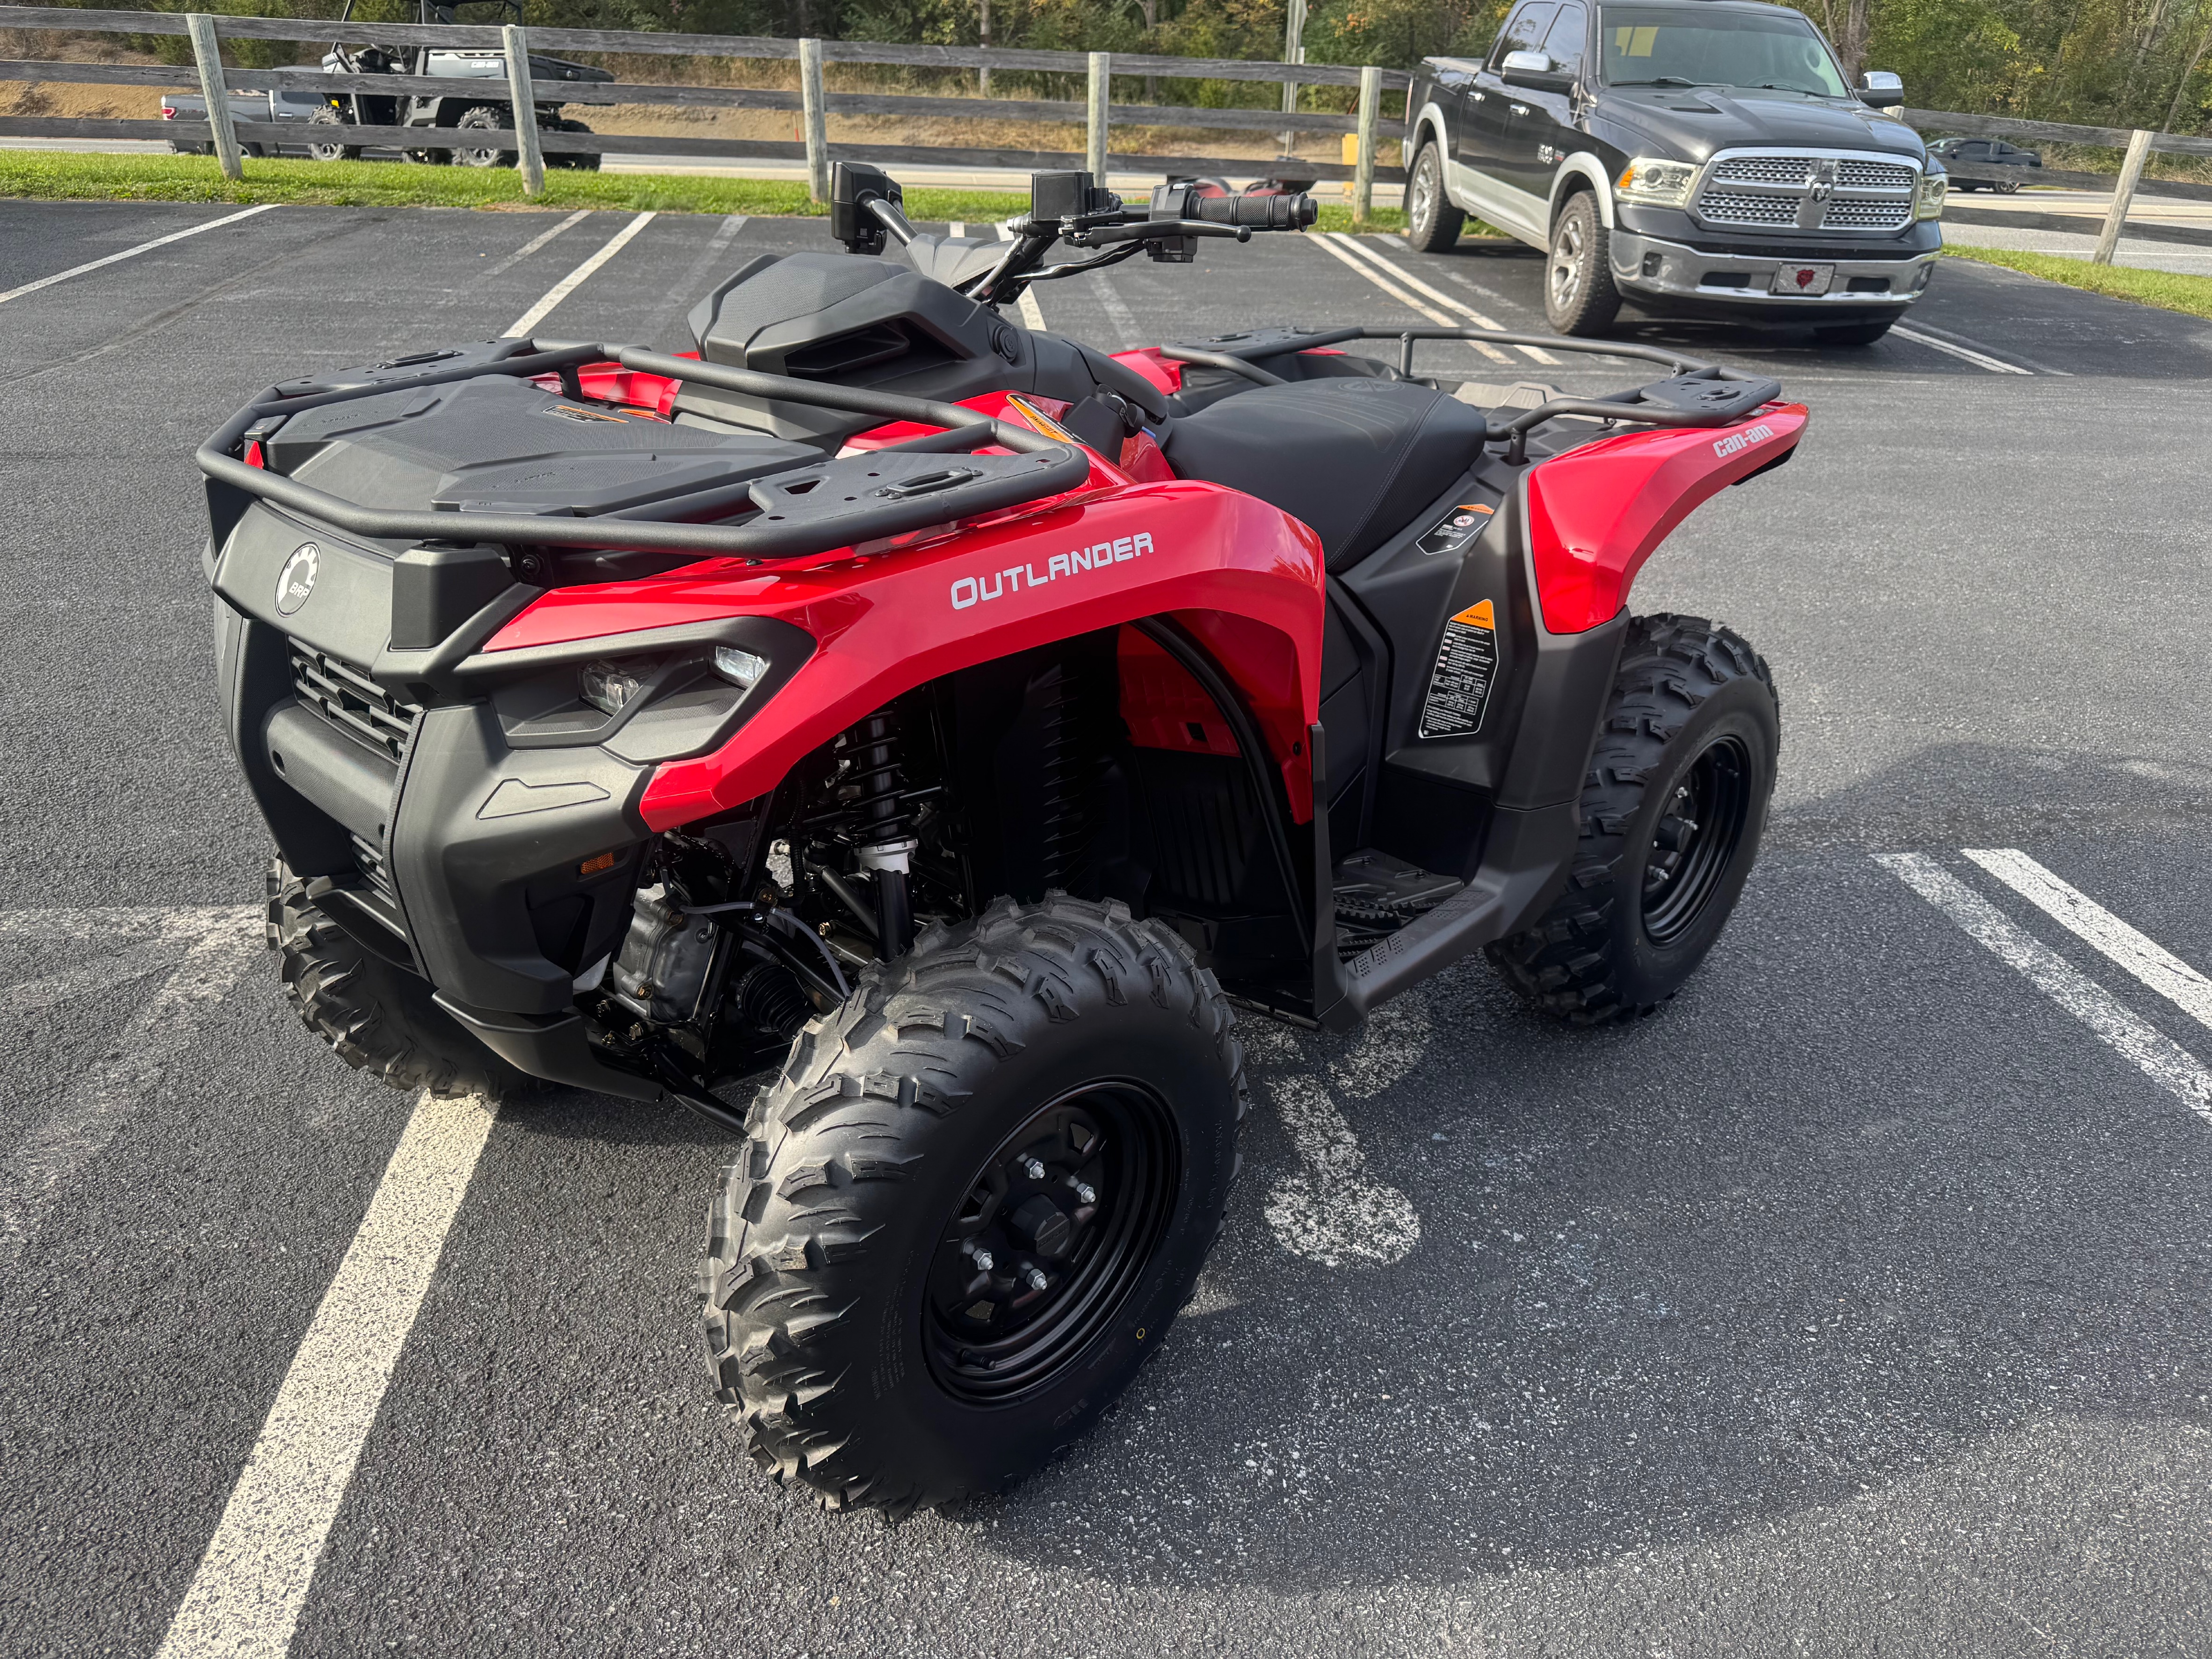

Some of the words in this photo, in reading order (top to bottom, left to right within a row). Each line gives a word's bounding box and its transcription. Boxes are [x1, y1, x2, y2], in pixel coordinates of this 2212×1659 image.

[1712, 424, 1774, 458] can-am
[951, 532, 1153, 610] OUTLANDER
[289, 582, 310, 598] BRP
